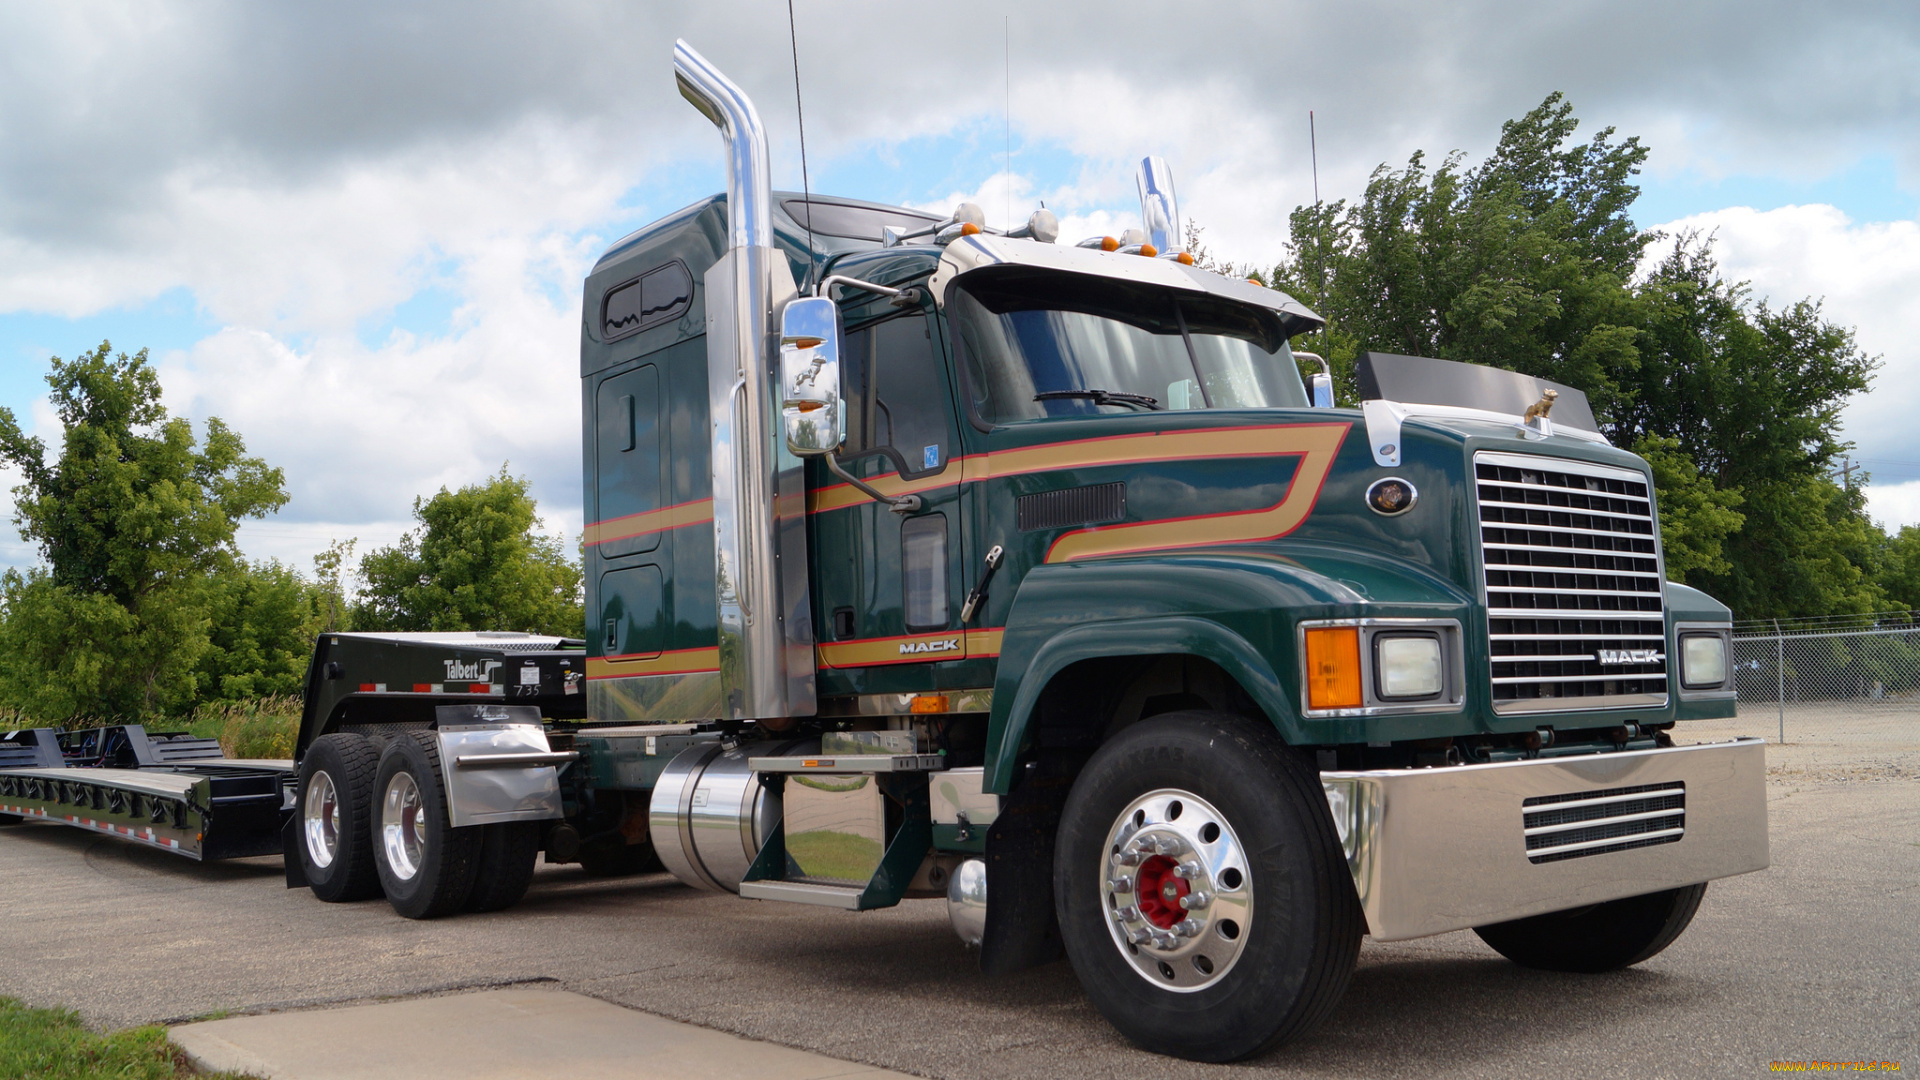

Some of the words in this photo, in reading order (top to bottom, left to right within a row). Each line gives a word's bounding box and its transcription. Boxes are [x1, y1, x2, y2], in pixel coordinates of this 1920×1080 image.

[899, 639, 959, 654] MACK
[1597, 649, 1660, 665] MACK
[443, 659, 479, 679] Talbert
[513, 684, 541, 697] 735
